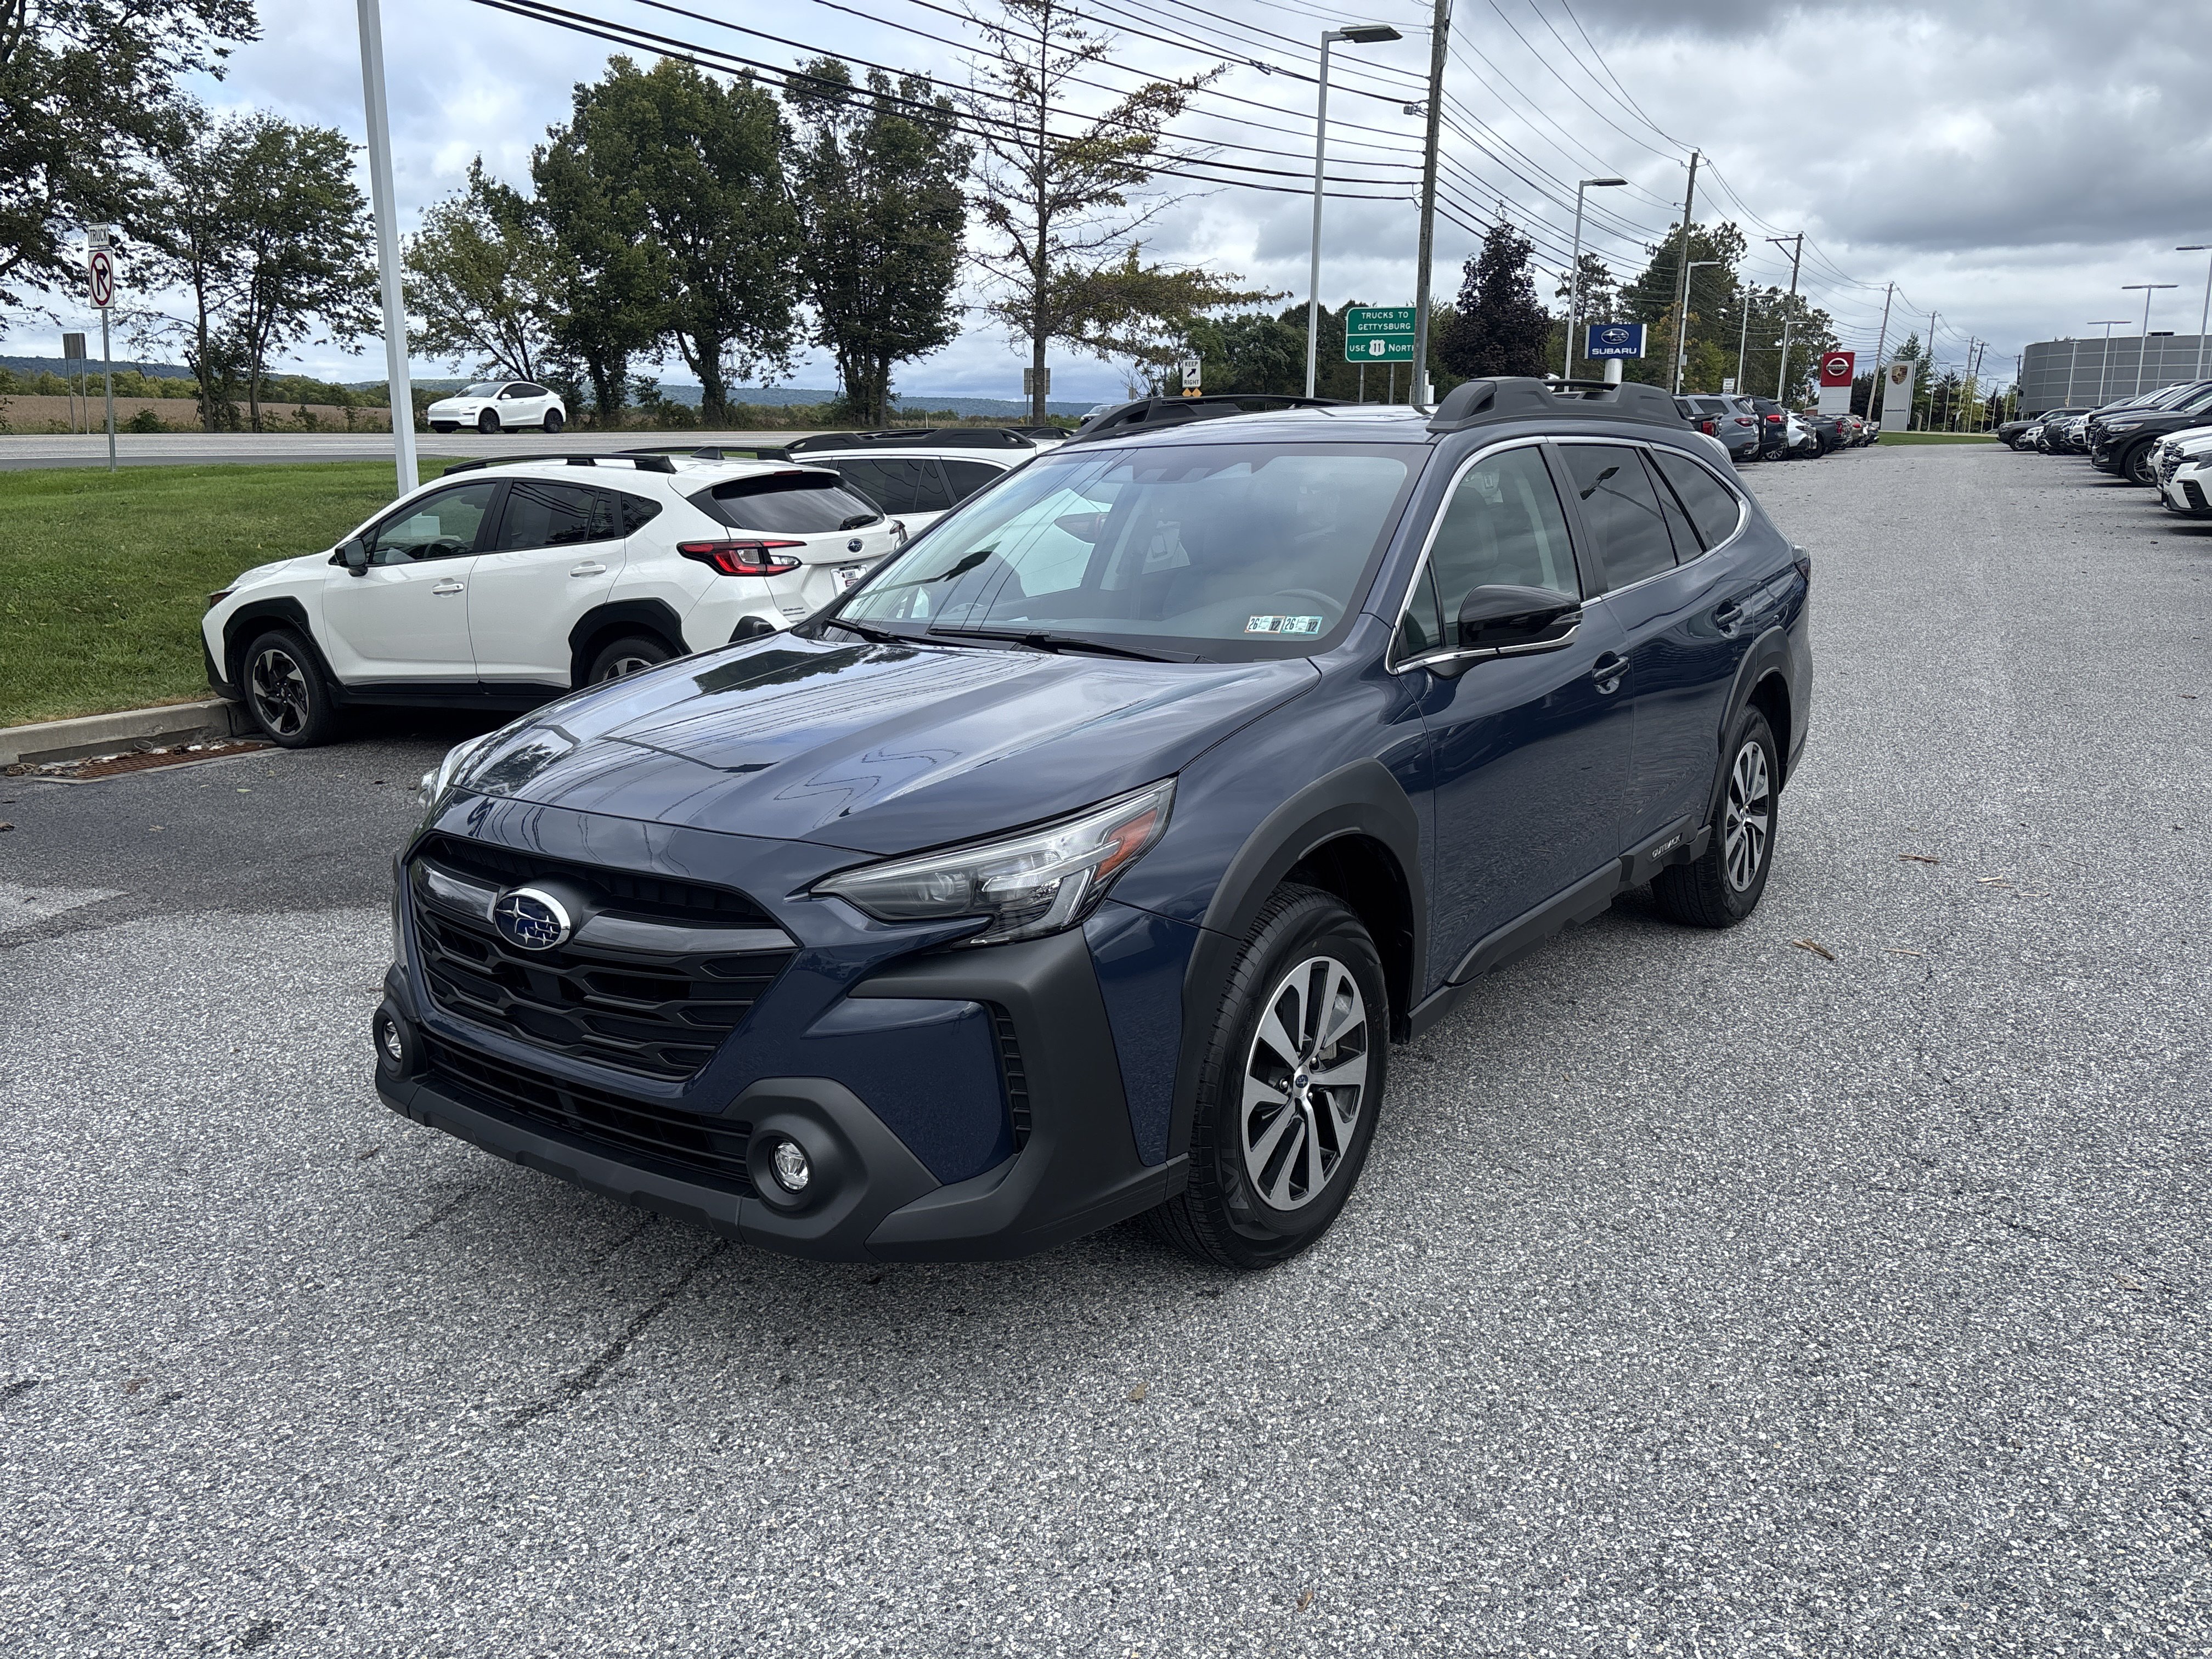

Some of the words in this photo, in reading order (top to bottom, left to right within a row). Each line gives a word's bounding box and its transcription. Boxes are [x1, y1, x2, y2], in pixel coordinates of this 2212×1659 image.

[89, 228, 108, 242] TRUCK
[1358, 323, 1411, 331] GETTYSBURG
[1373, 343, 1381, 353] 11
[1248, 618, 1260, 630] 26
[1269, 620, 1281, 631] 12
[1284, 618, 1296, 630] 26
[1307, 621, 1318, 632] 12
[1651, 834, 1681, 858] OUTBACK
